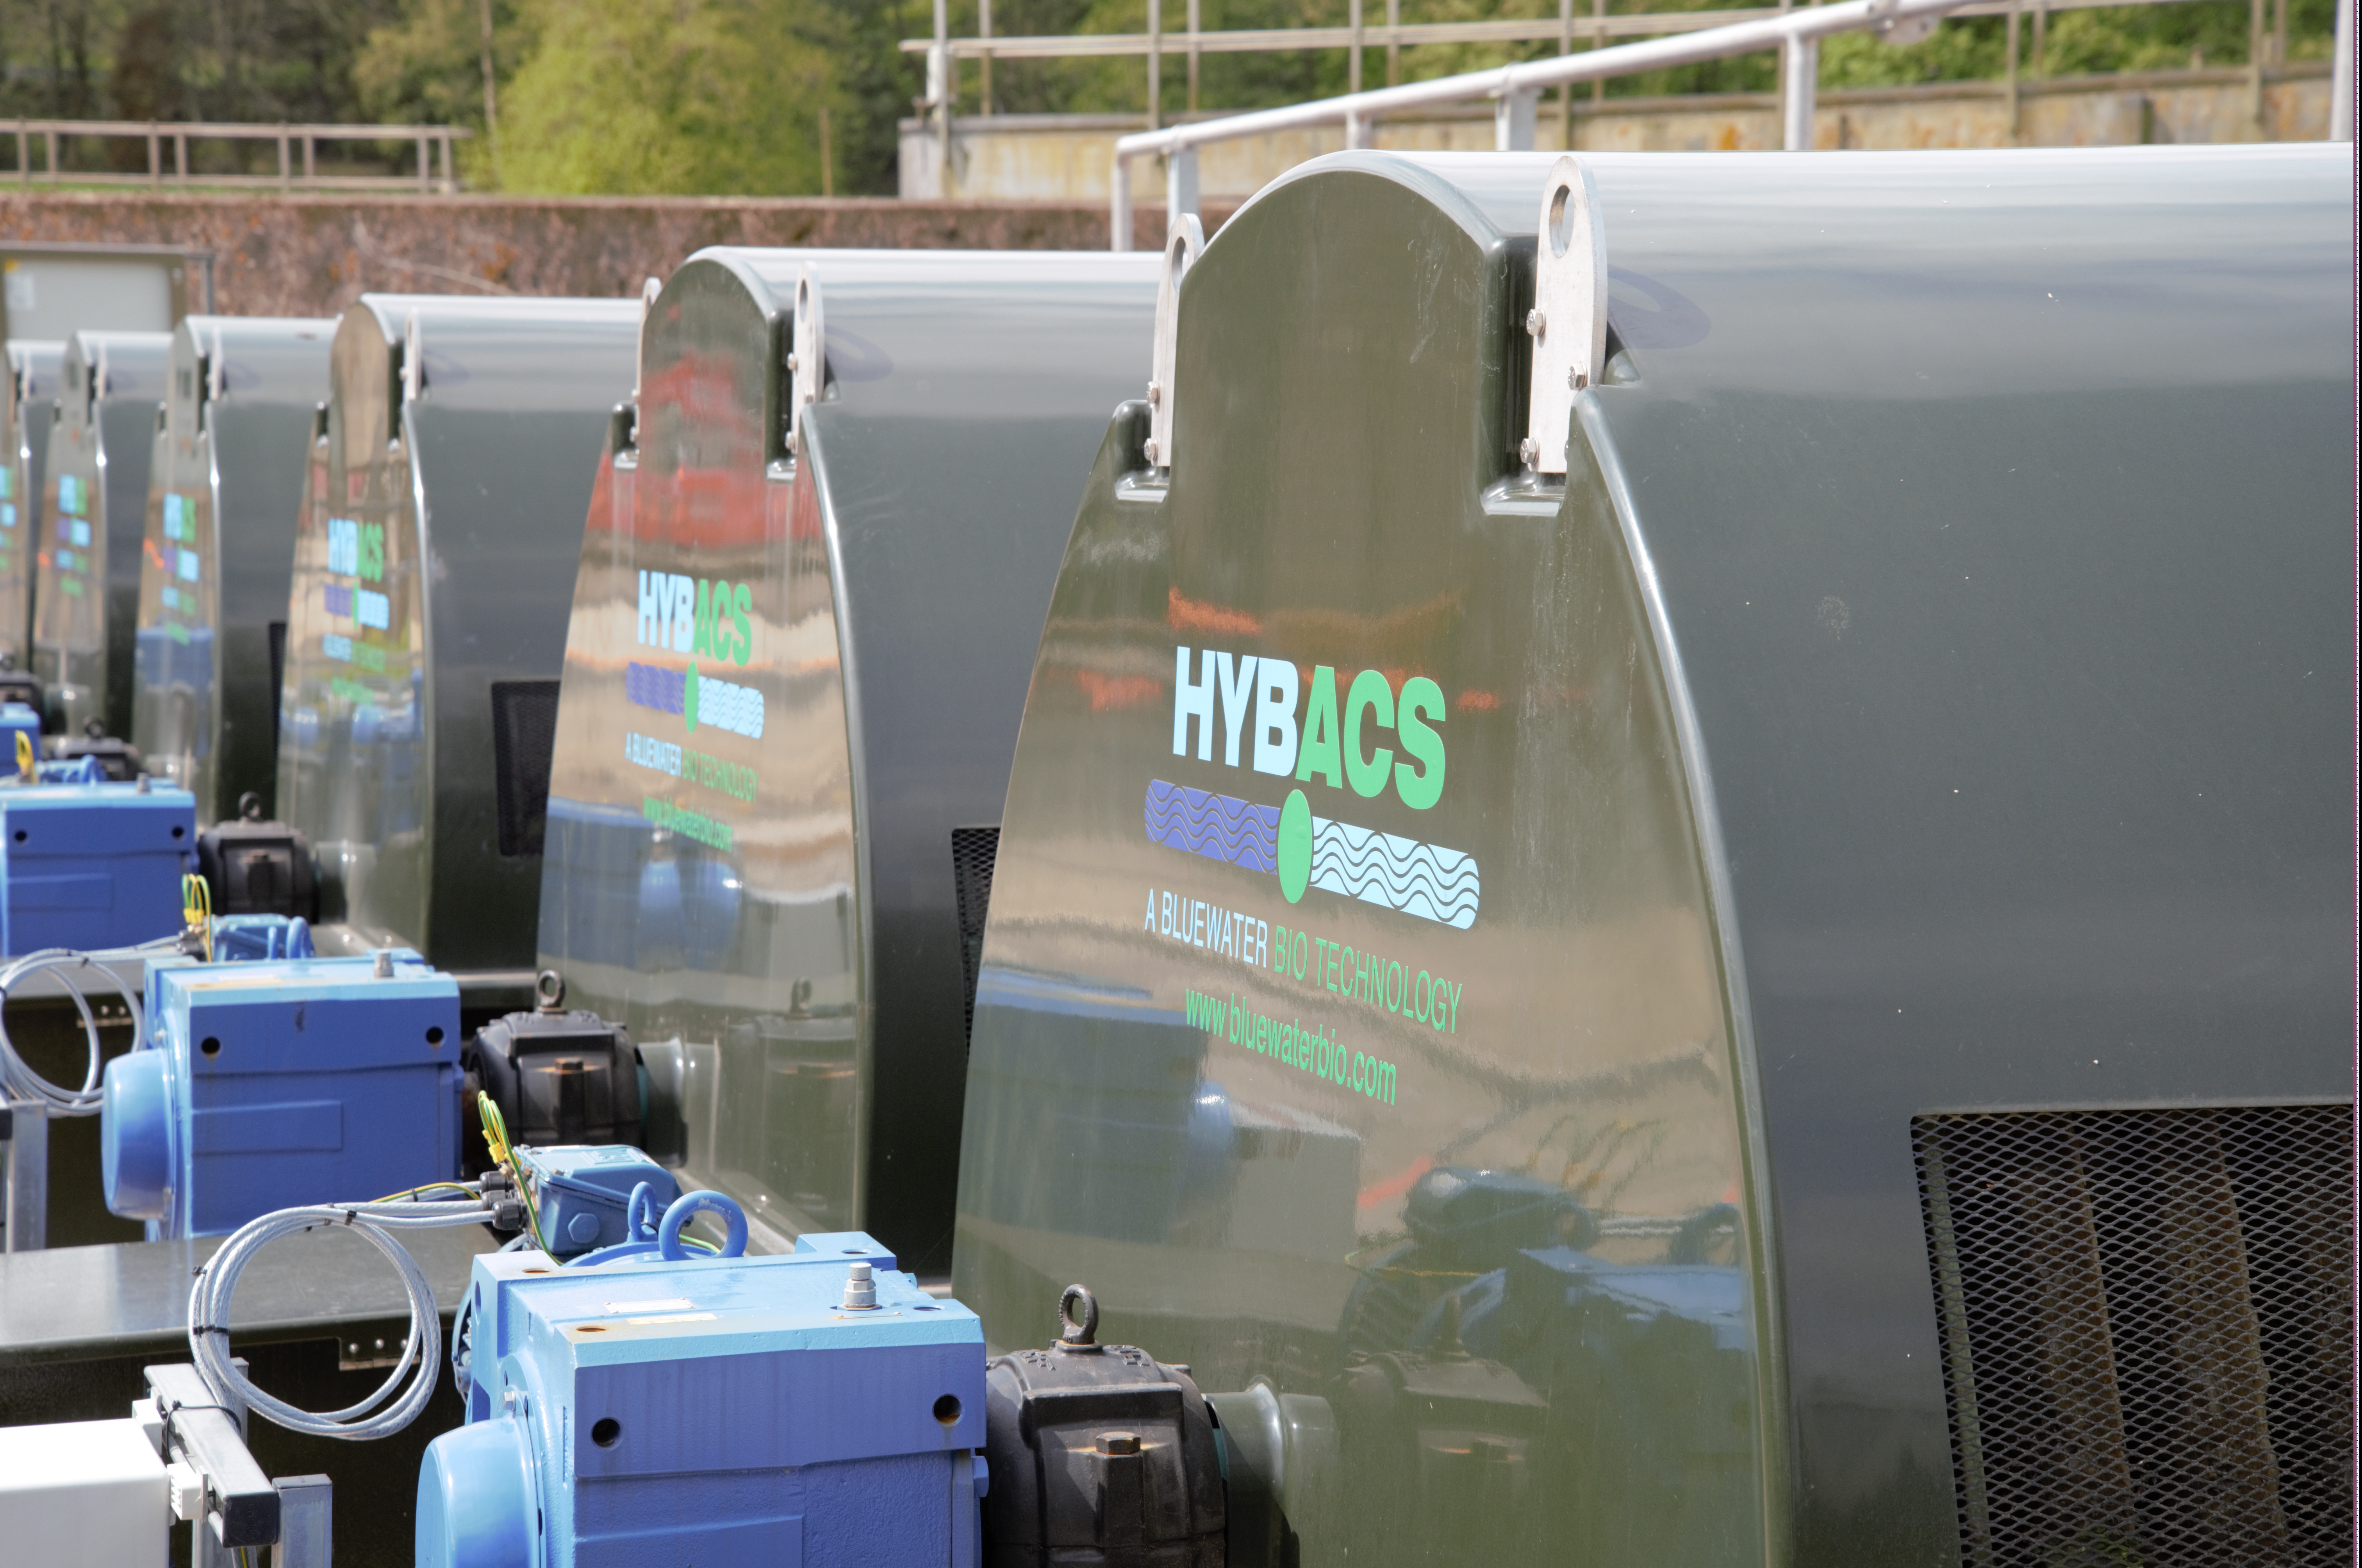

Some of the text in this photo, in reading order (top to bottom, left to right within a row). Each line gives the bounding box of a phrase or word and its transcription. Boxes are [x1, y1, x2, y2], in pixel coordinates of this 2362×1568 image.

[637, 569, 752, 667] HYBACS
[624, 731, 759, 803] A BLUEWATER BIO TECHNOLOGY
[1173, 645, 1446, 810] HYBACS
[1144, 888, 1463, 1033] A BLUEWATER BIO TECHNOLOGY
